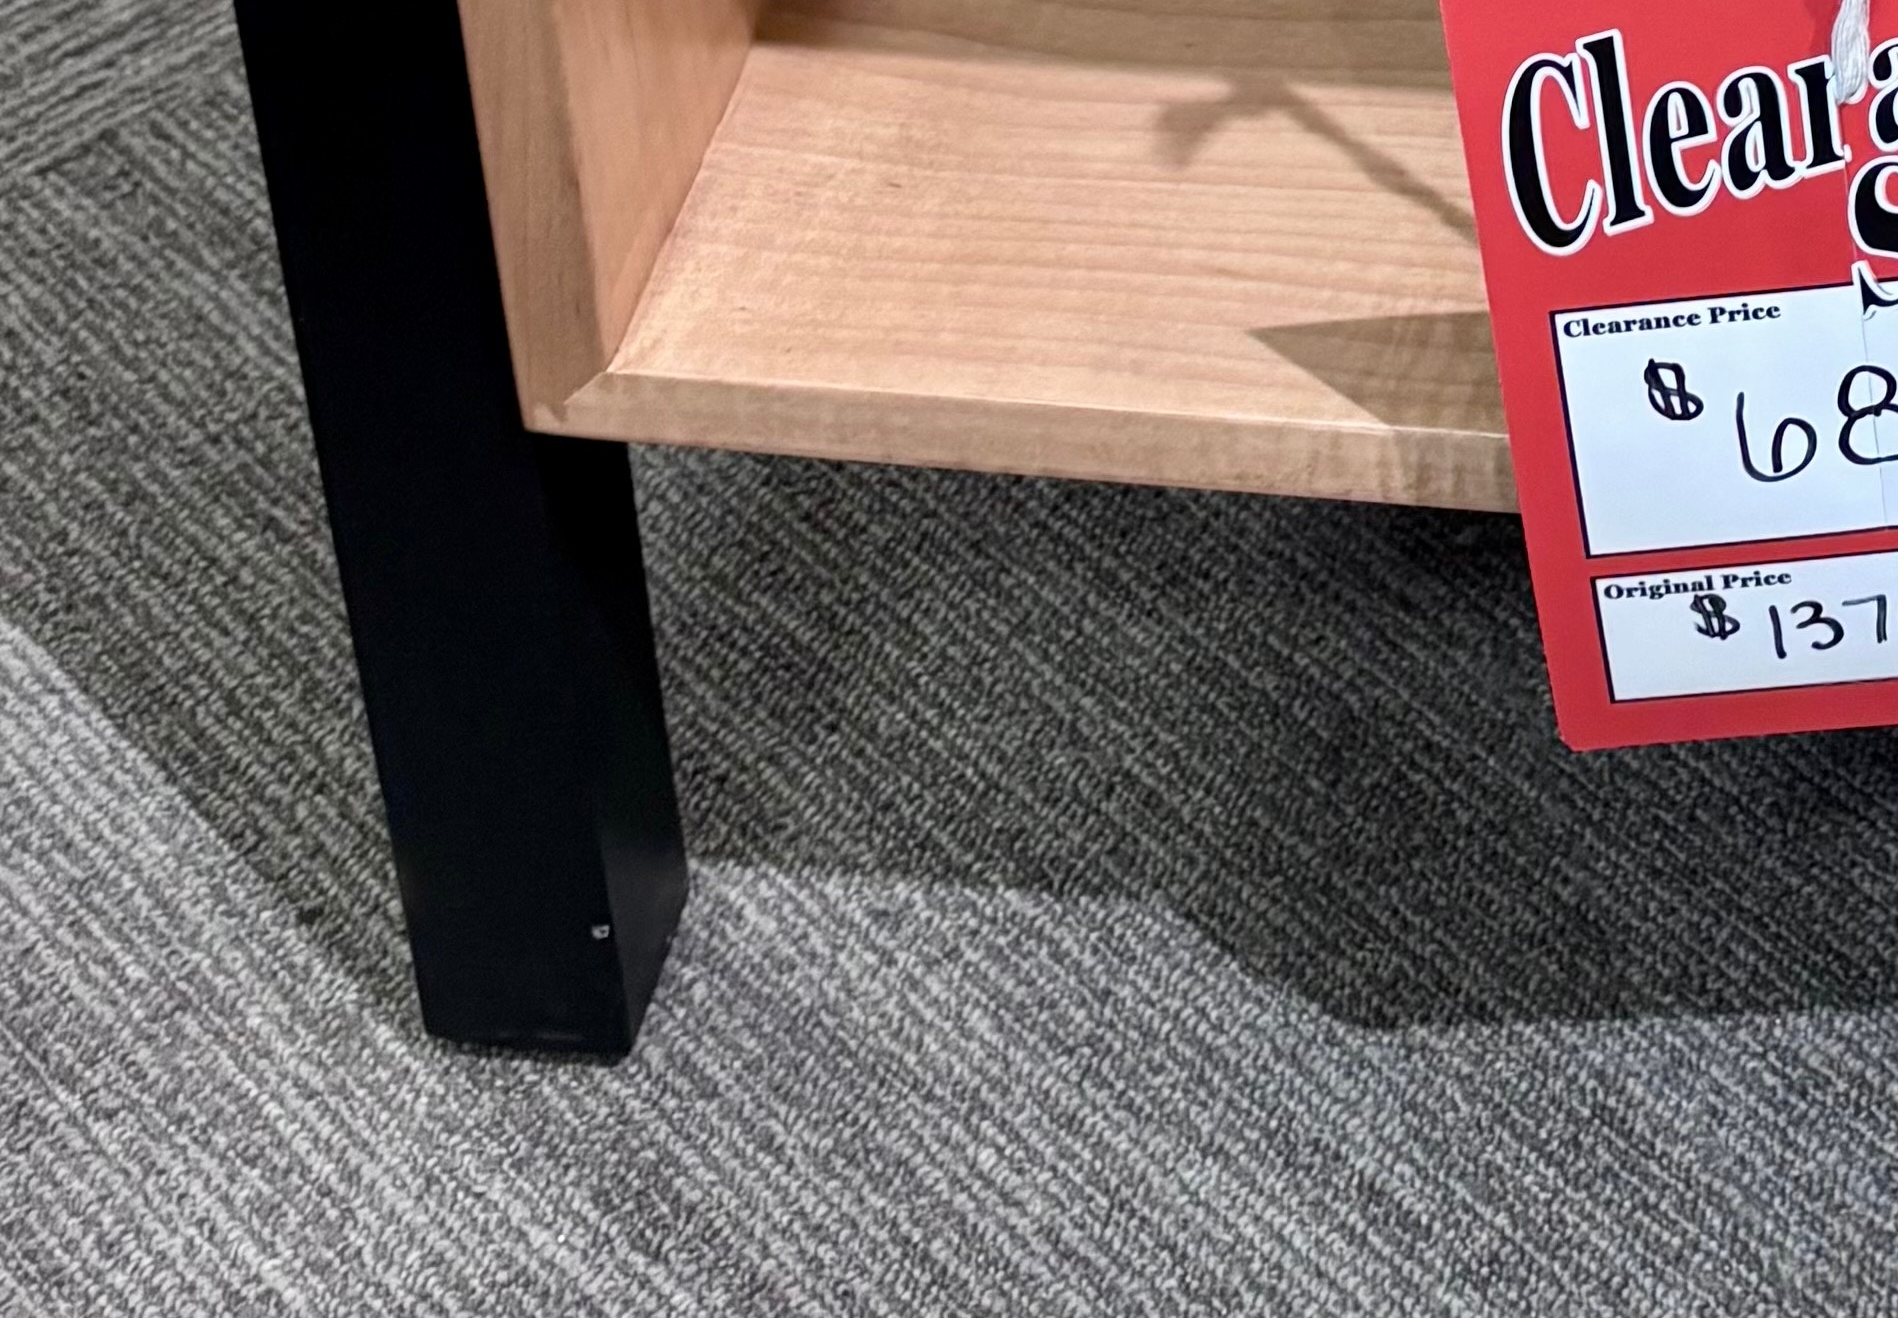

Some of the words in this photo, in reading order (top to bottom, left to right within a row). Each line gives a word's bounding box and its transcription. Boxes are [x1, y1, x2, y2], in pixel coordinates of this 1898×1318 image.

[1562, 312, 1702, 339] Clearance
[1707, 302, 1783, 325] Price
[1602, 575, 1716, 601] Original
[1721, 569, 1793, 591] Price
